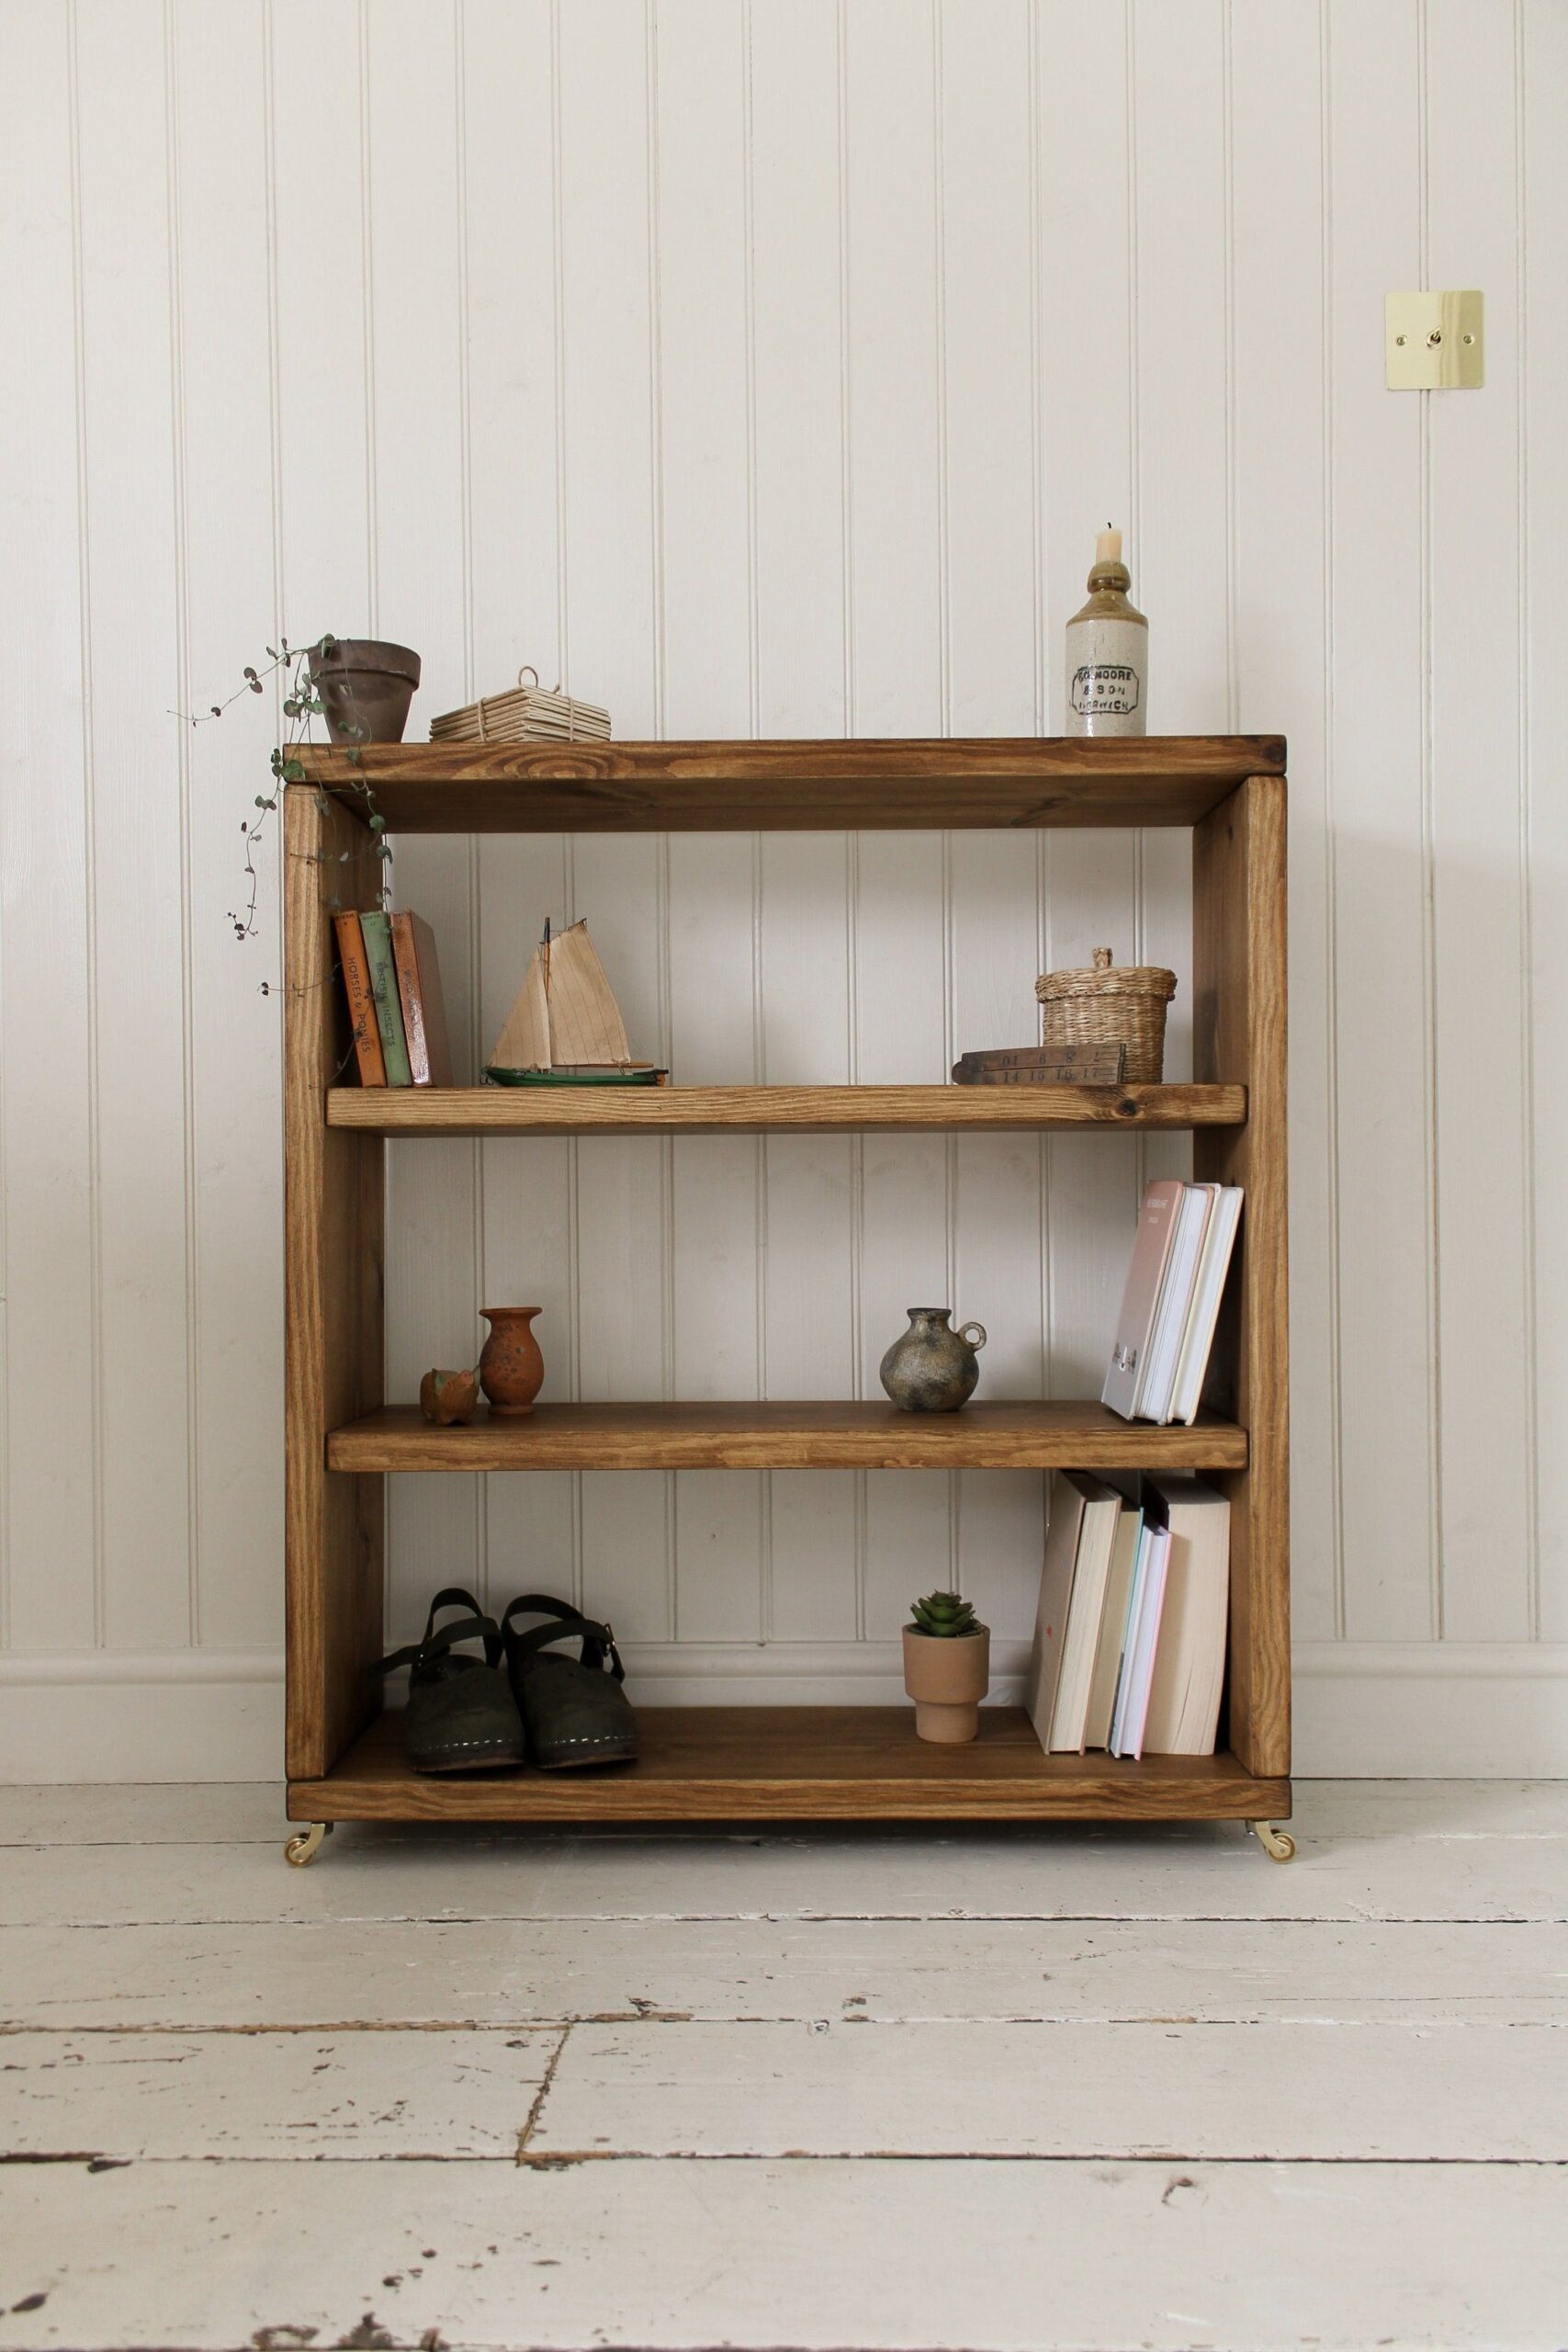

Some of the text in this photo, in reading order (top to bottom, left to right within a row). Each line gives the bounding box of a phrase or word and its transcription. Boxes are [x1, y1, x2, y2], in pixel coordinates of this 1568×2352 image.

[1097, 684, 1125, 695] SON
[347, 957, 361, 999] HORSES
[359, 1013, 371, 1053] PONIES
[376, 962, 395, 1046] BRITISH INSECTS
[1003, 1071, 1020, 1082] 14
[1030, 1070, 1045, 1081] 15
